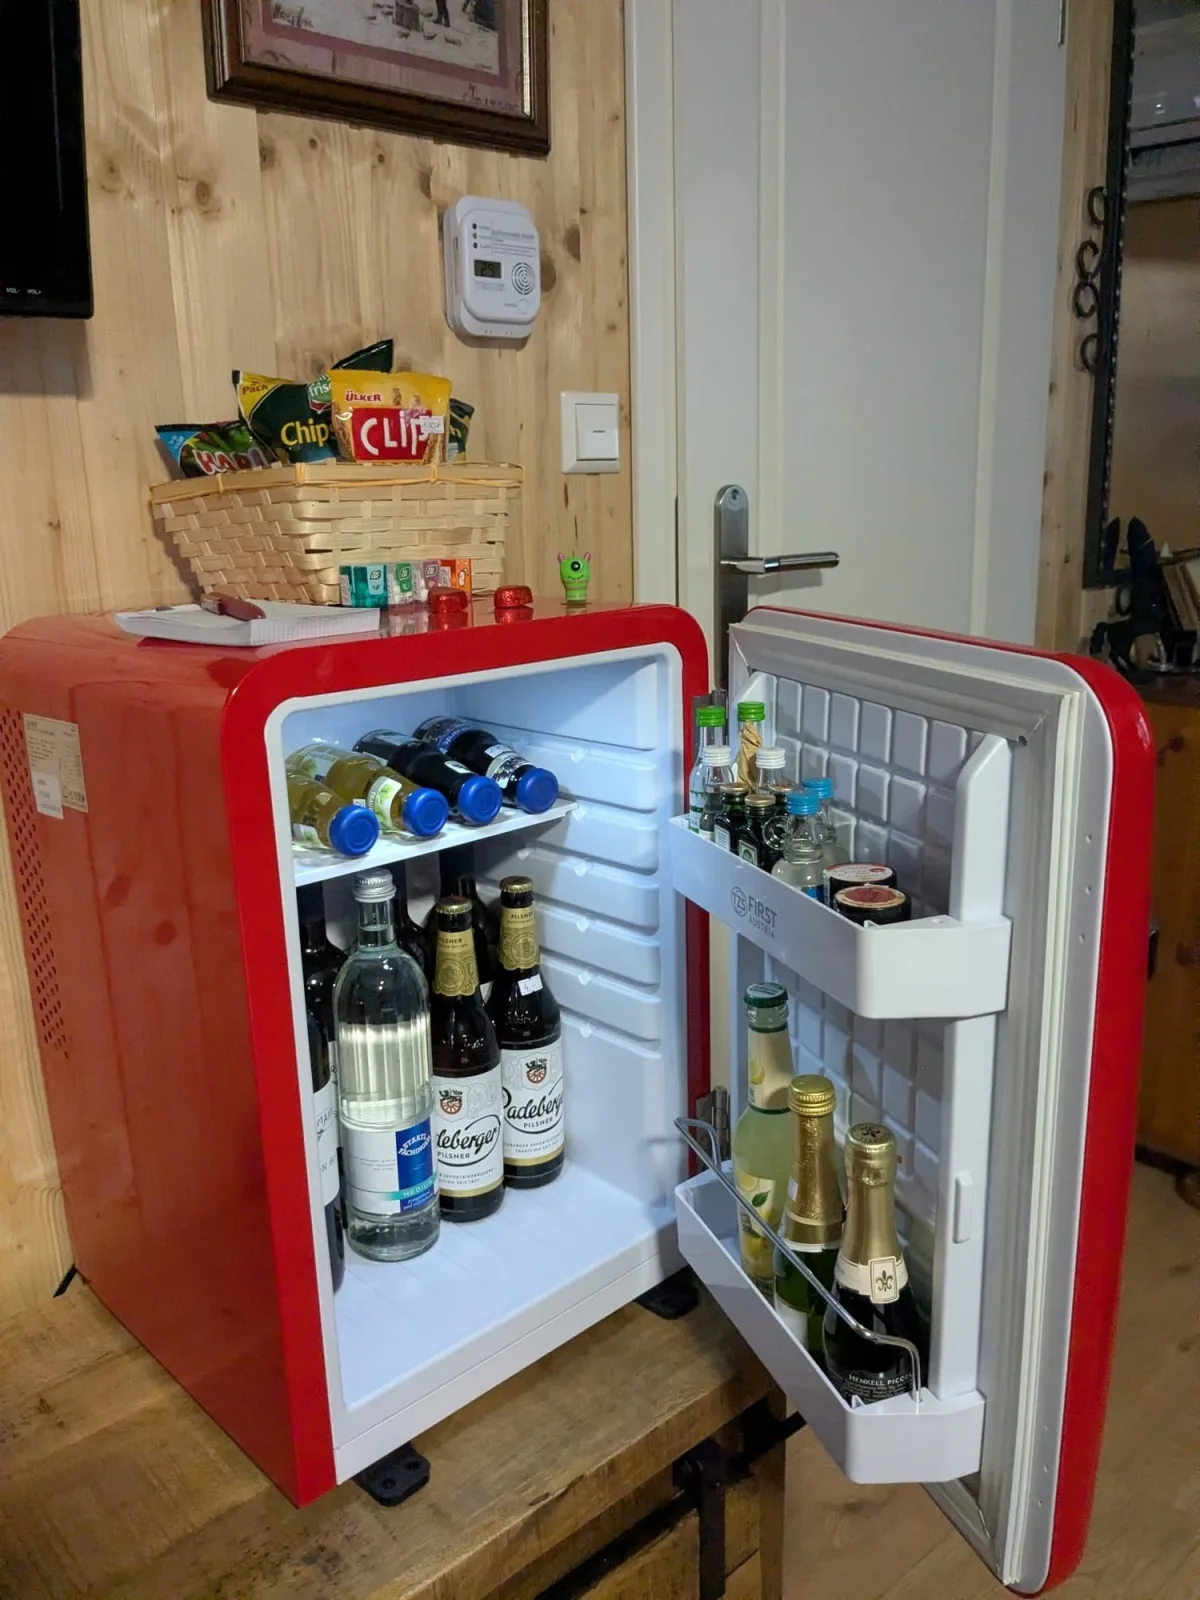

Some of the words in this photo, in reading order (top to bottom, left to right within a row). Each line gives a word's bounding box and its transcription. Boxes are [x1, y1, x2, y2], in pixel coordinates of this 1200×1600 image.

[242, 384, 268, 395] Pack
[346, 390, 381, 402] ÜLKER
[749, 895, 777, 928] FIRST
[523, 1117, 553, 1129] PILSNER
[437, 1151, 471, 1160] PILSNER
[848, 1373, 886, 1386] HENKELL
